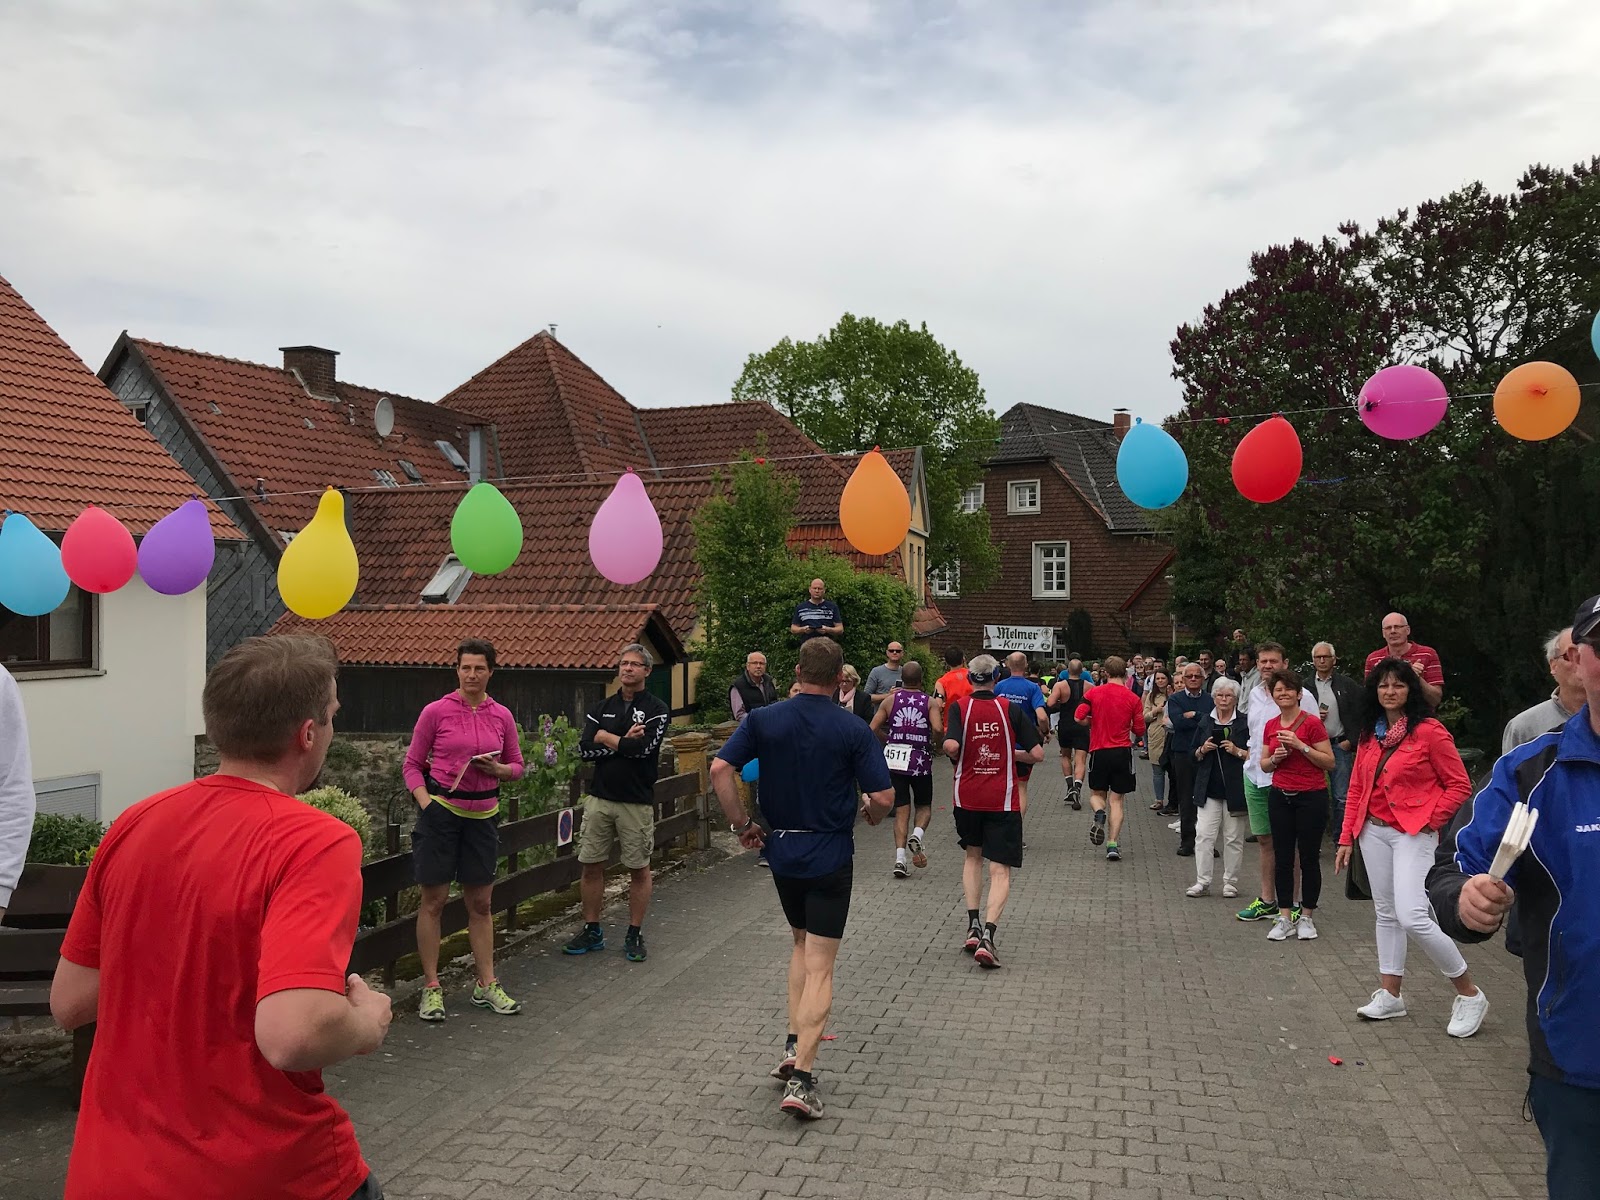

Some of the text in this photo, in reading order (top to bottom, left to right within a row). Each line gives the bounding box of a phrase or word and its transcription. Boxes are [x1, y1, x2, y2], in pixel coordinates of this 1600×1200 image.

[998, 640, 1035, 650] -Kurve
[975, 722, 999, 732] LEG
[905, 733, 928, 742] SENDE
[885, 749, 907, 762] 4511
[1575, 823, 1600, 832] JAK
